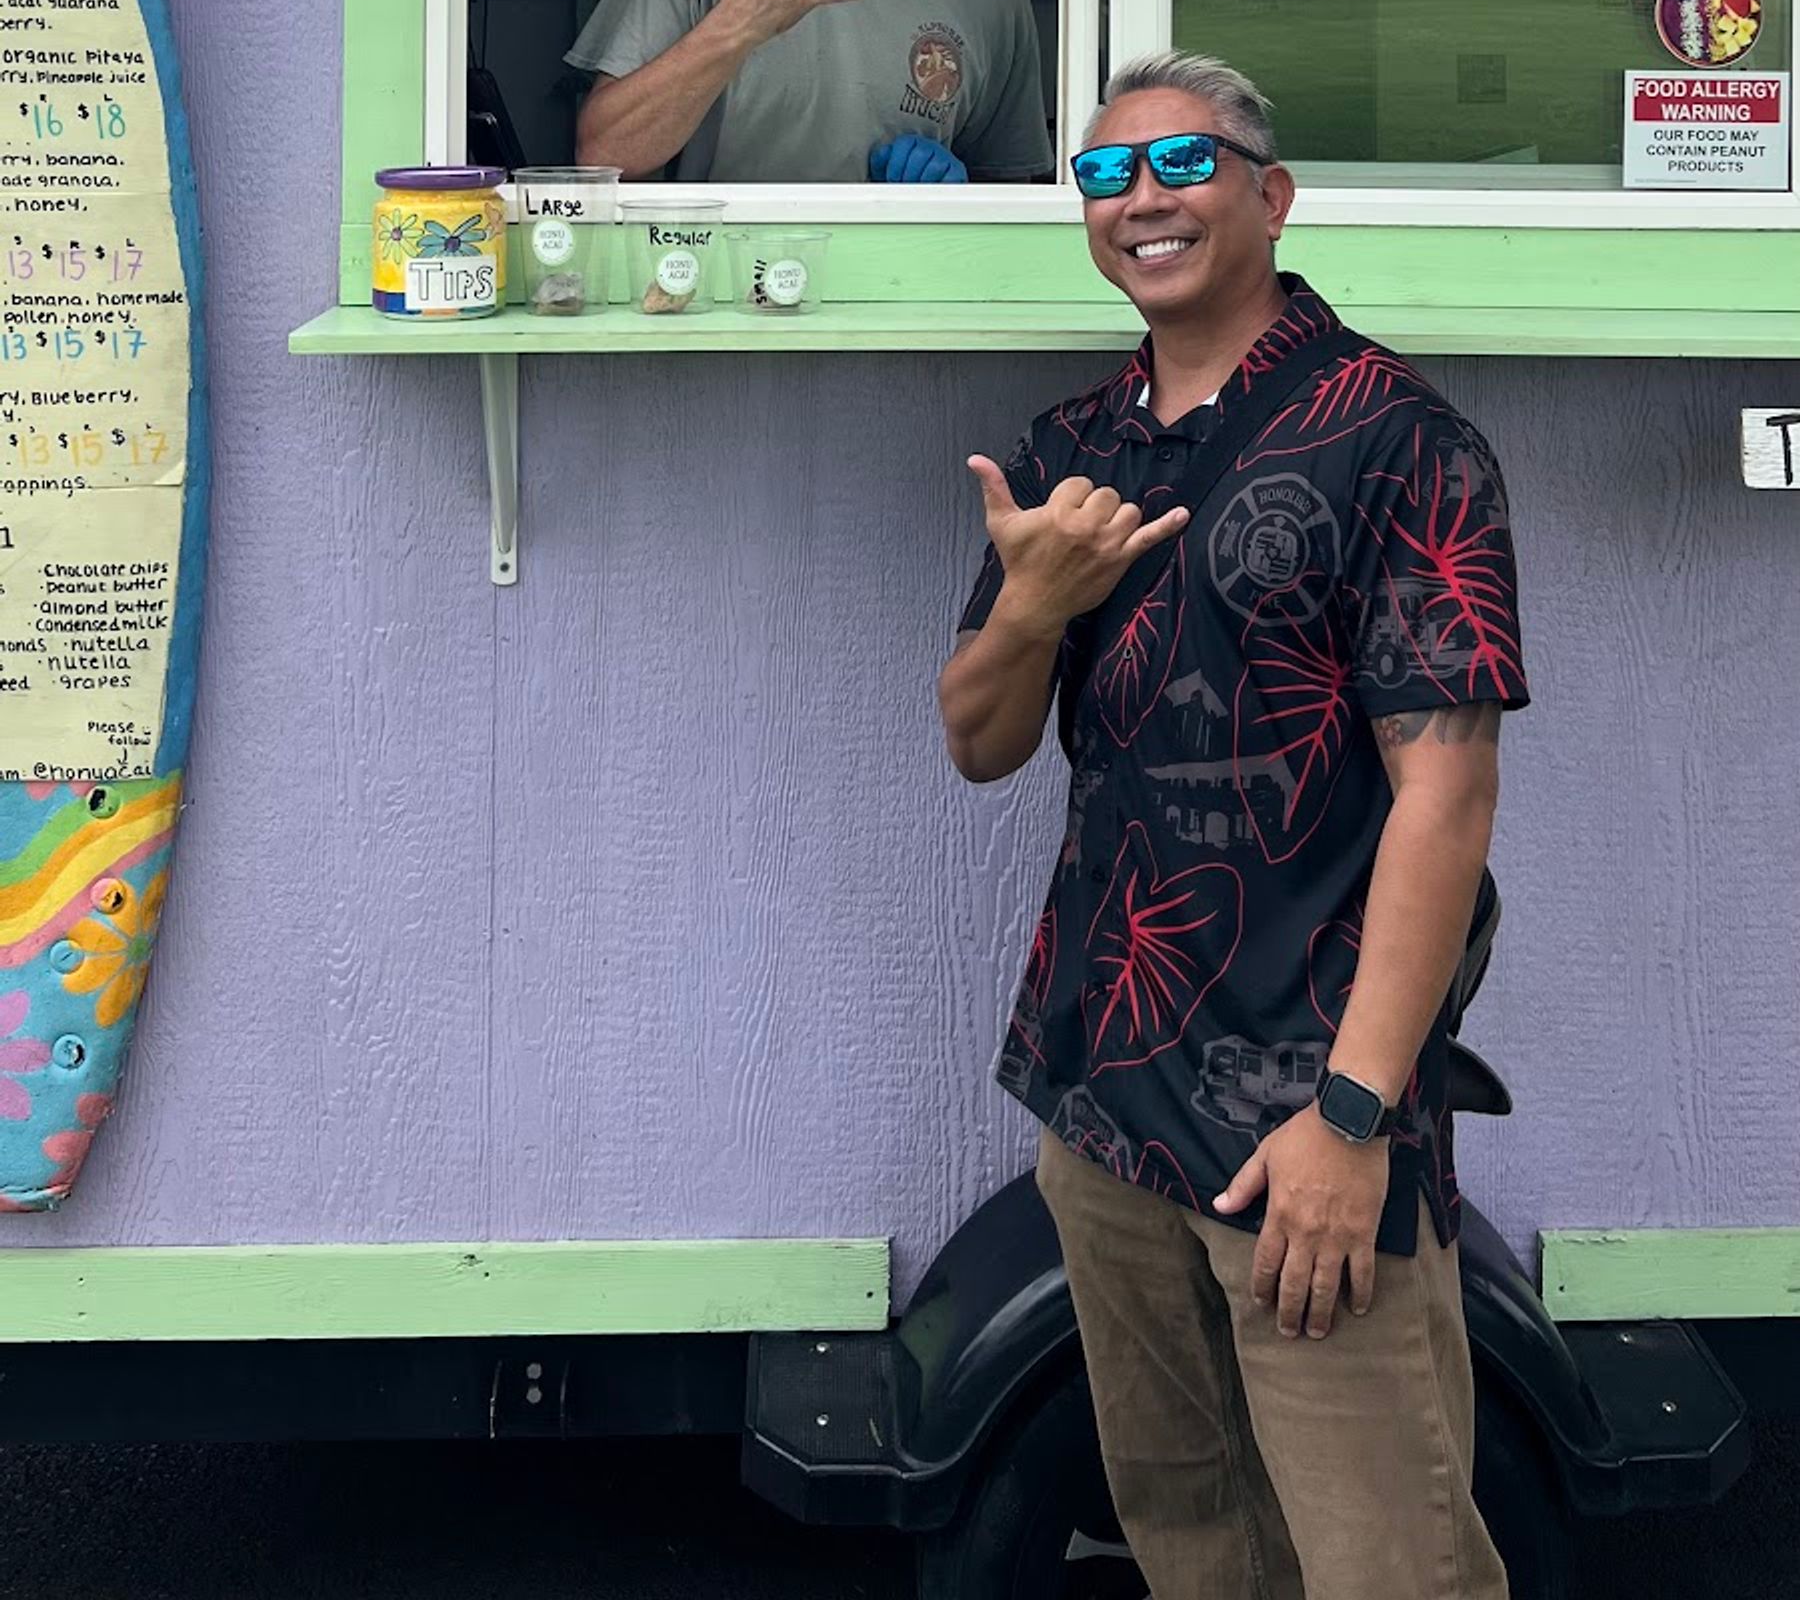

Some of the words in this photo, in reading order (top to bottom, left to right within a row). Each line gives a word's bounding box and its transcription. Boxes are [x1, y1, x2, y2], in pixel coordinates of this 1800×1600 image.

[109, 70, 146, 84] juice
[1634, 80, 1688, 98] FOOD
[1690, 81, 1780, 99] ALLERGY
[1661, 103, 1752, 121] WARNING
[1654, 129, 1684, 142] OUR
[1687, 129, 1727, 142] FOOD
[1730, 129, 1759, 142] MAY
[1646, 145, 1707, 157] CONTAIN
[1711, 145, 1767, 157] PEANUT
[1667, 160, 1745, 173] PRODUCTS
[649, 224, 713, 247] Regular
[665, 259, 692, 271] HONU
[113, 578, 168, 592] butter
[115, 599, 168, 613] butter
[122, 615, 168, 631] milk
[71, 637, 151, 652] nutella
[48, 657, 131, 673] nutella
[60, 674, 132, 690] grapes
[108, 735, 151, 747] follow
